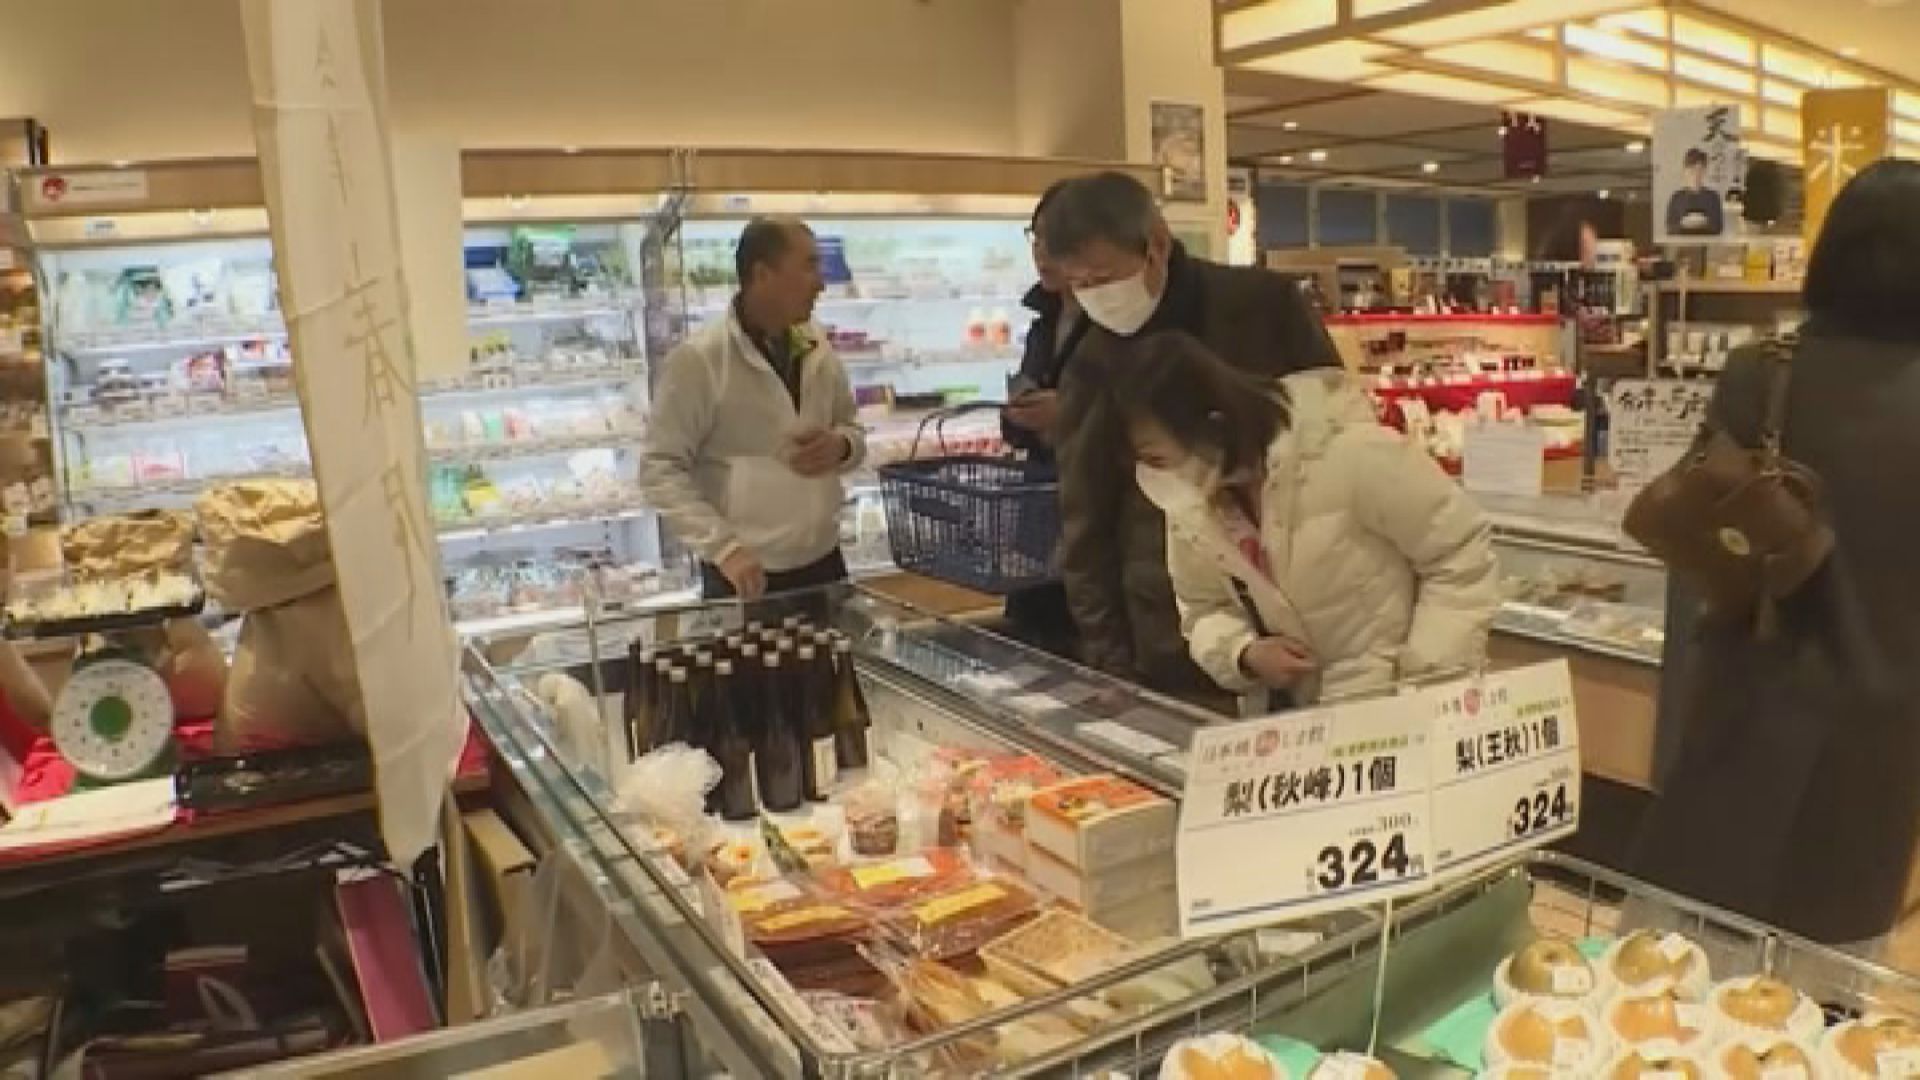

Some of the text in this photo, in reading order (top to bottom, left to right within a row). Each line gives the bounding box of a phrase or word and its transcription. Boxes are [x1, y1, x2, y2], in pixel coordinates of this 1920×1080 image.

[1222, 755, 1397, 817] 梨(秋峰)1個
[1514, 782, 1567, 836] 324
[1317, 831, 1409, 890] 324
